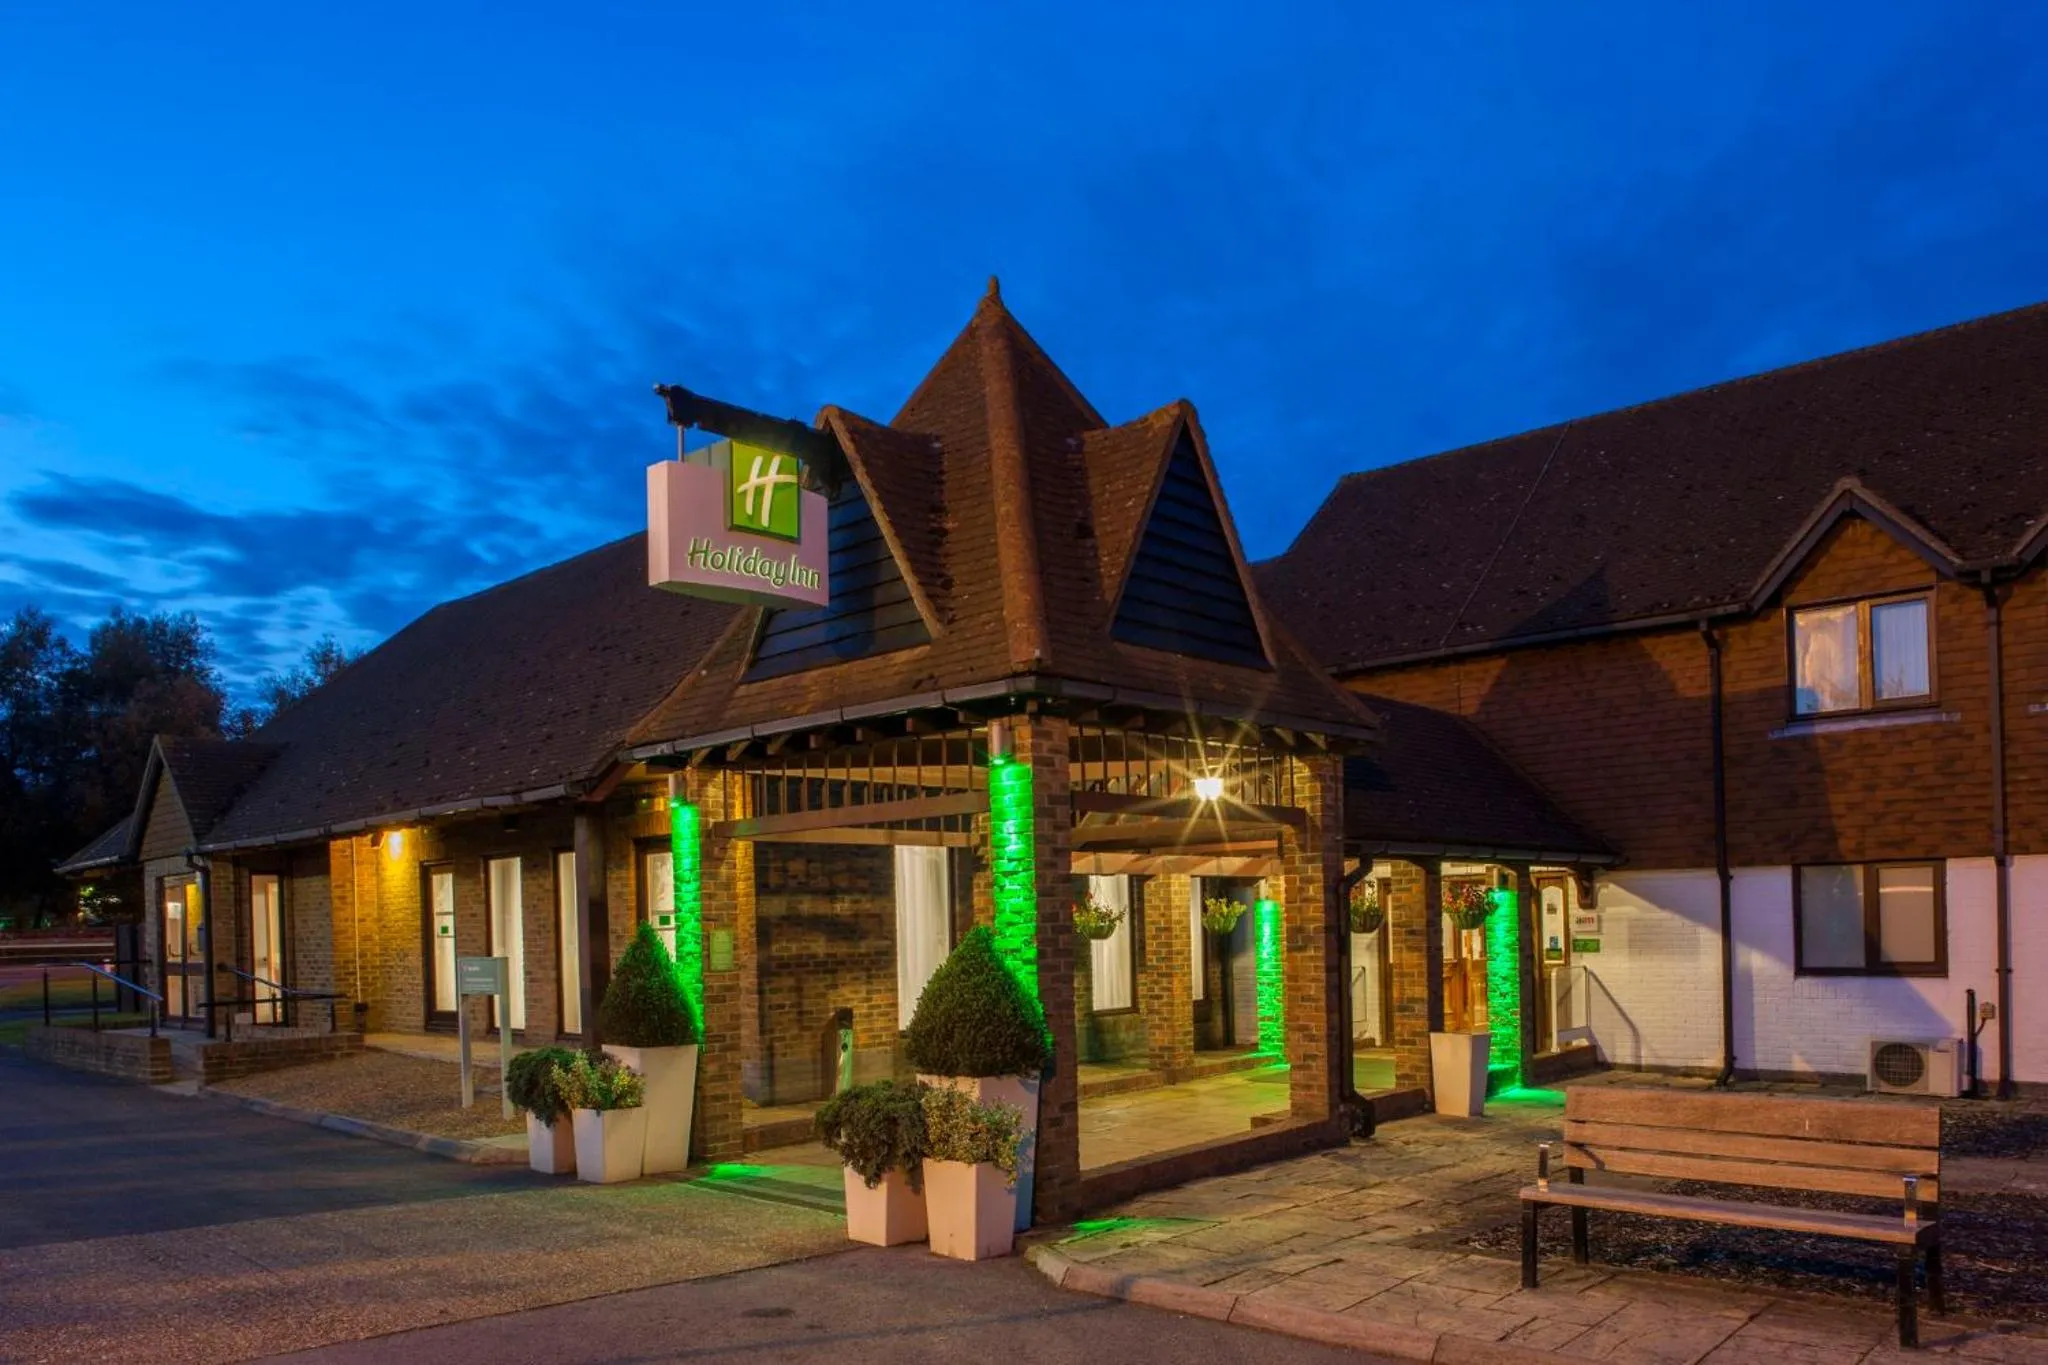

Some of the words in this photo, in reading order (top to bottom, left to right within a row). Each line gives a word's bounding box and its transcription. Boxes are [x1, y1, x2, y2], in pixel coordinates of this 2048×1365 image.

[737, 456, 798, 527] H
[687, 537, 787, 587] Holiday
[789, 554, 821, 590] Inn
